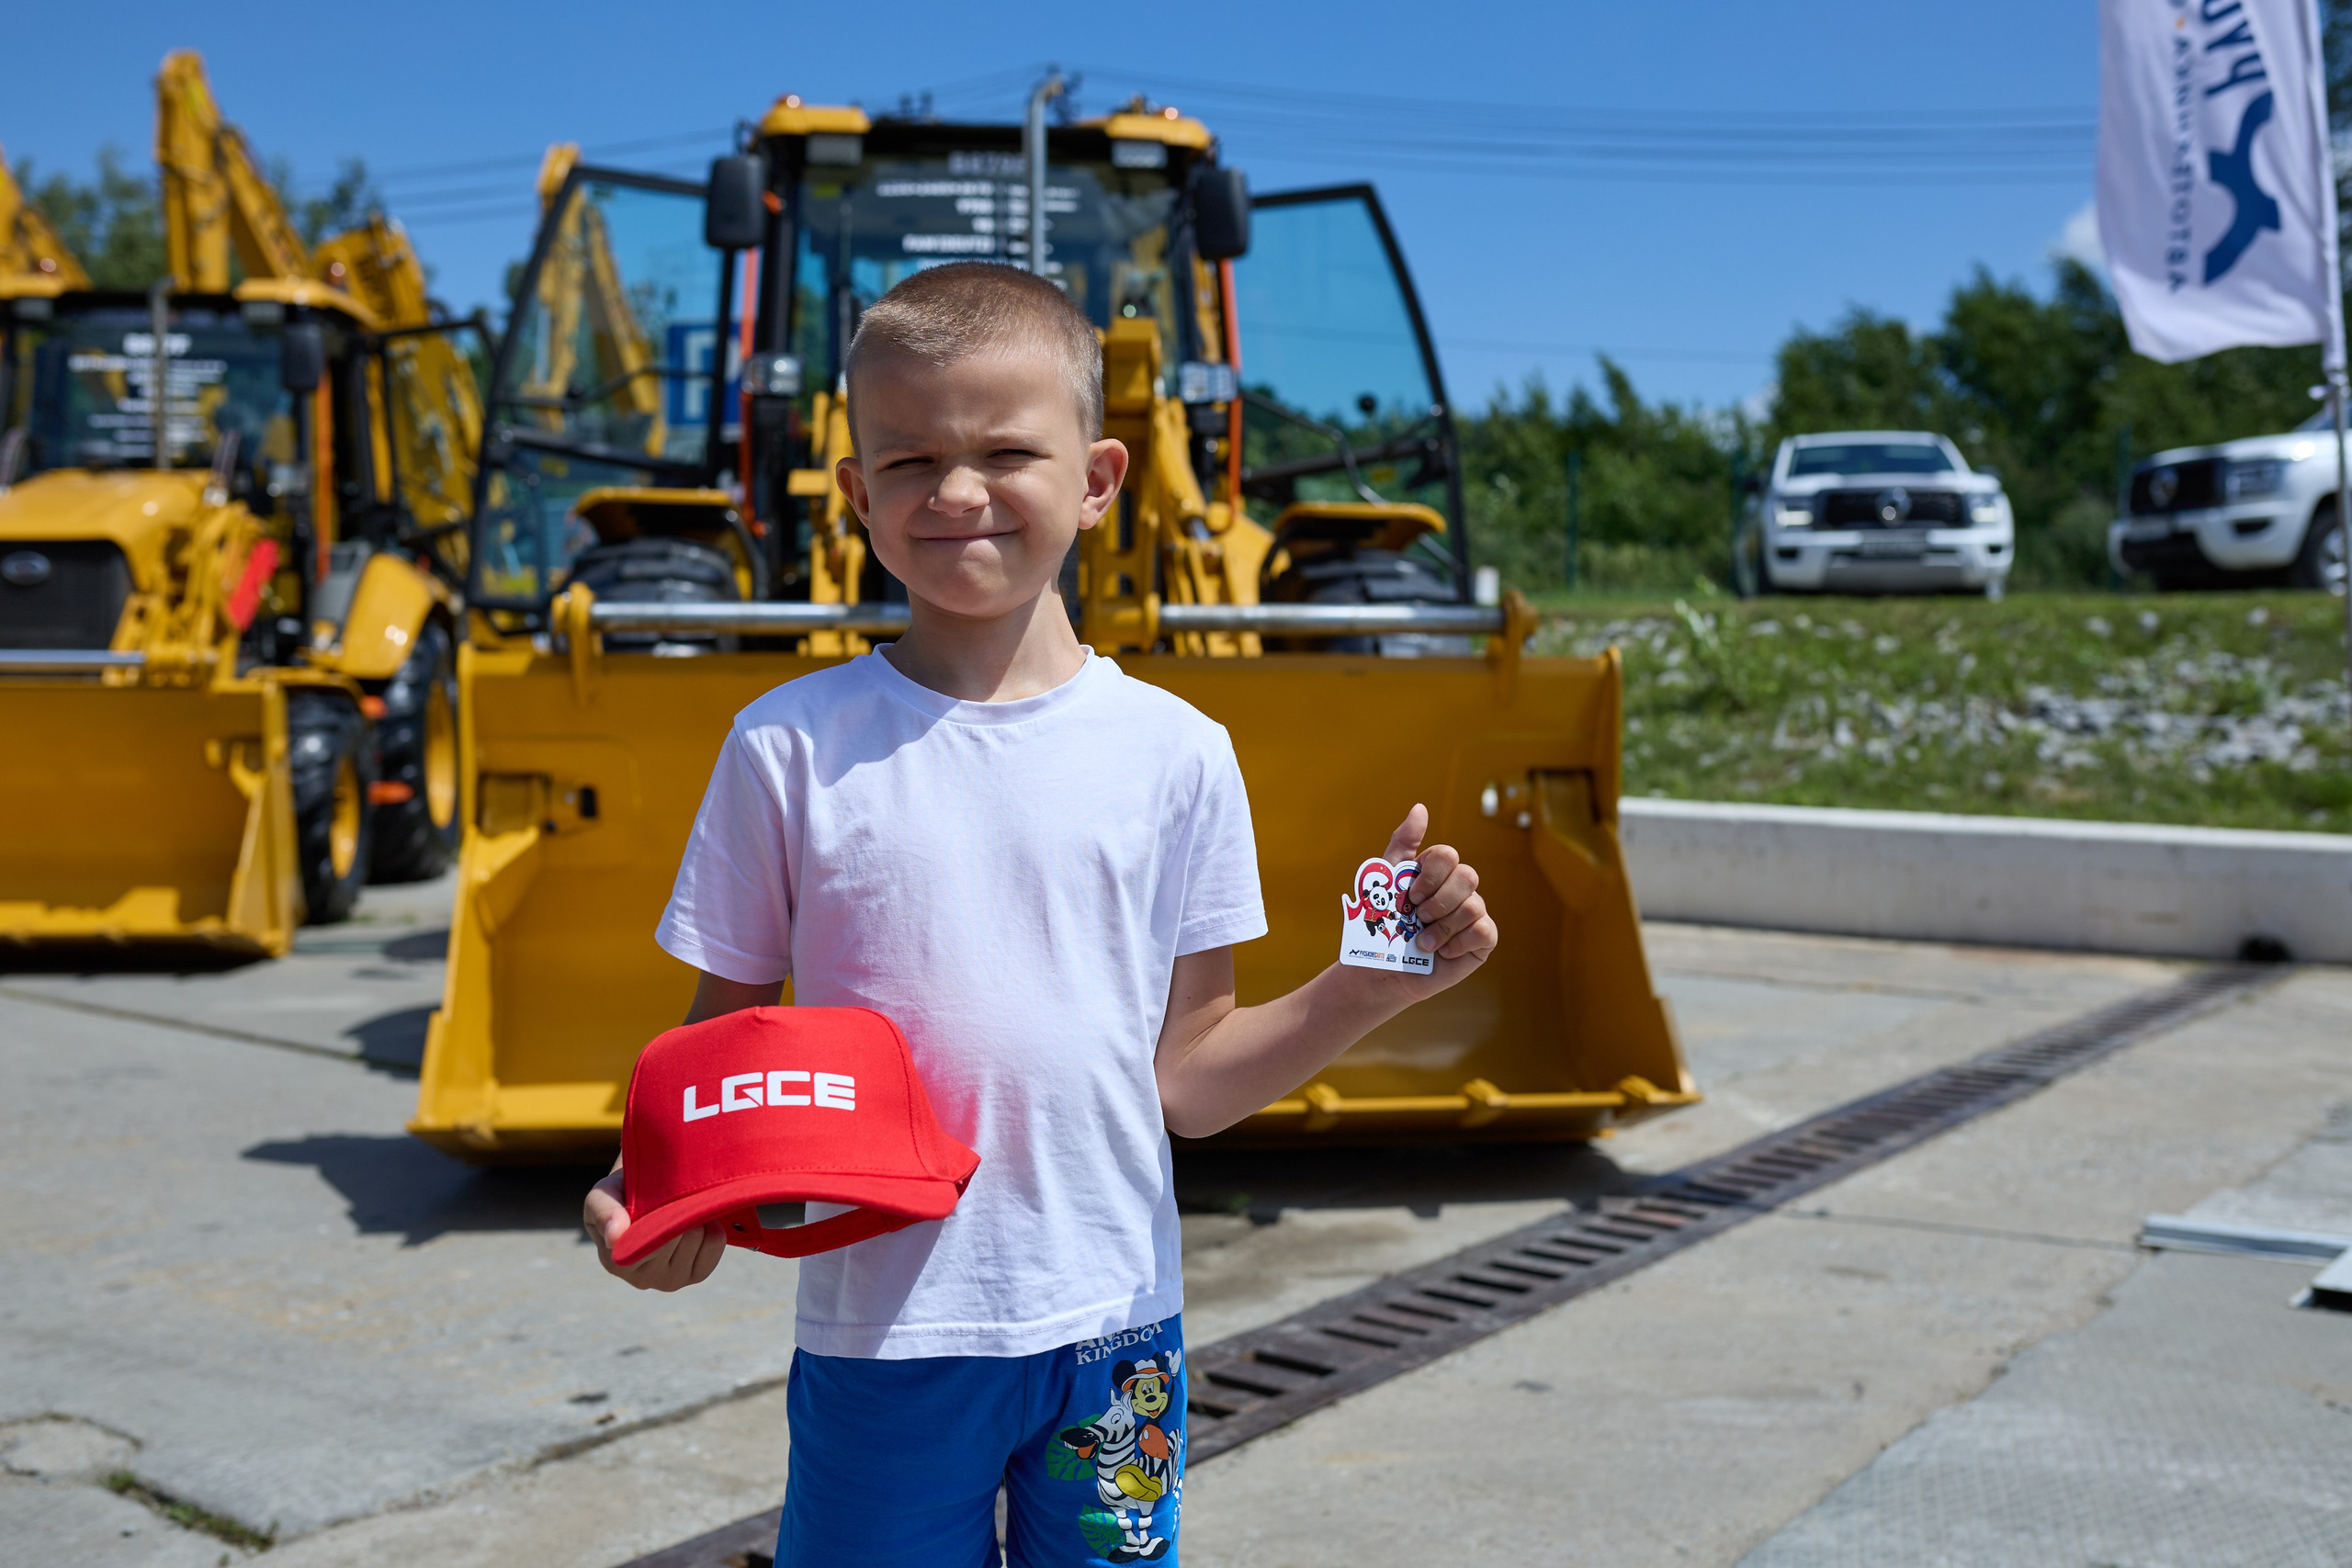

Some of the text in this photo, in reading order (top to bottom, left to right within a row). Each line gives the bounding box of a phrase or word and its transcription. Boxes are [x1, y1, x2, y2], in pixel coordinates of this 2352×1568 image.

[1402, 955, 1430, 966] LGCE
[683, 1070, 856, 1123] LGCE
[1075, 1323, 1163, 1366] KINGDOM
